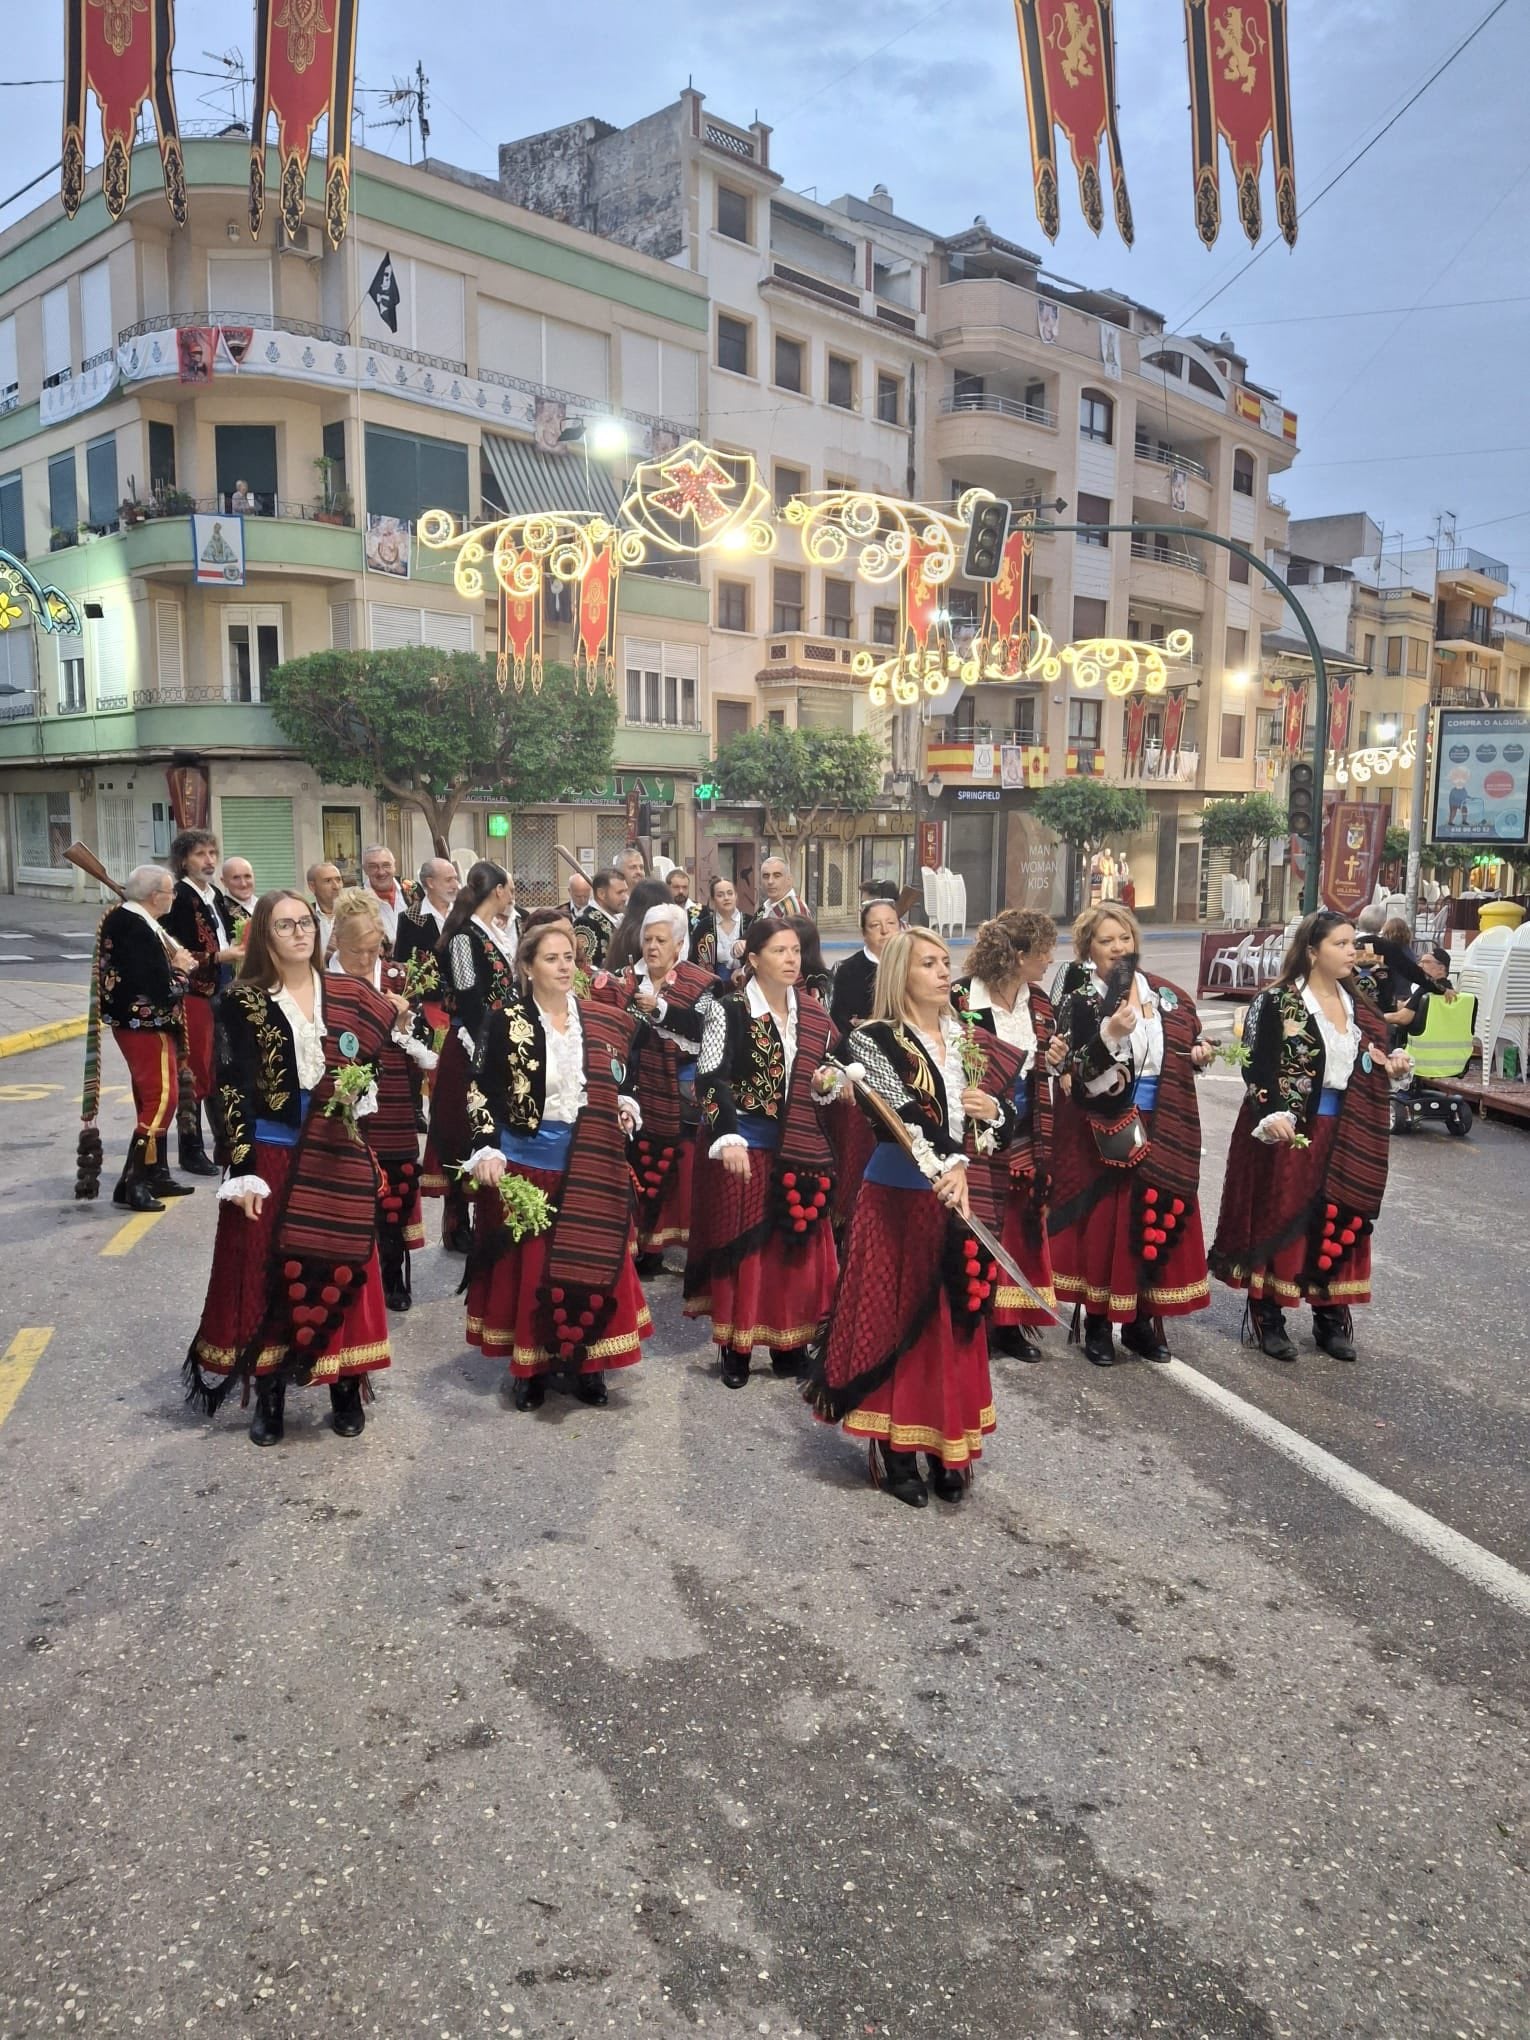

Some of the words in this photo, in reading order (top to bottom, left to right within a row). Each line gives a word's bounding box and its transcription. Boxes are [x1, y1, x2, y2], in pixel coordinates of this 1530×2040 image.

[1448, 719, 1482, 727] COMPRA
[957, 790, 1000, 801] SPRINGFIELD
[1029, 845, 1050, 857] MAN
[1020, 861, 1058, 873] WOMAN
[1028, 877, 1049, 888] KIDS
